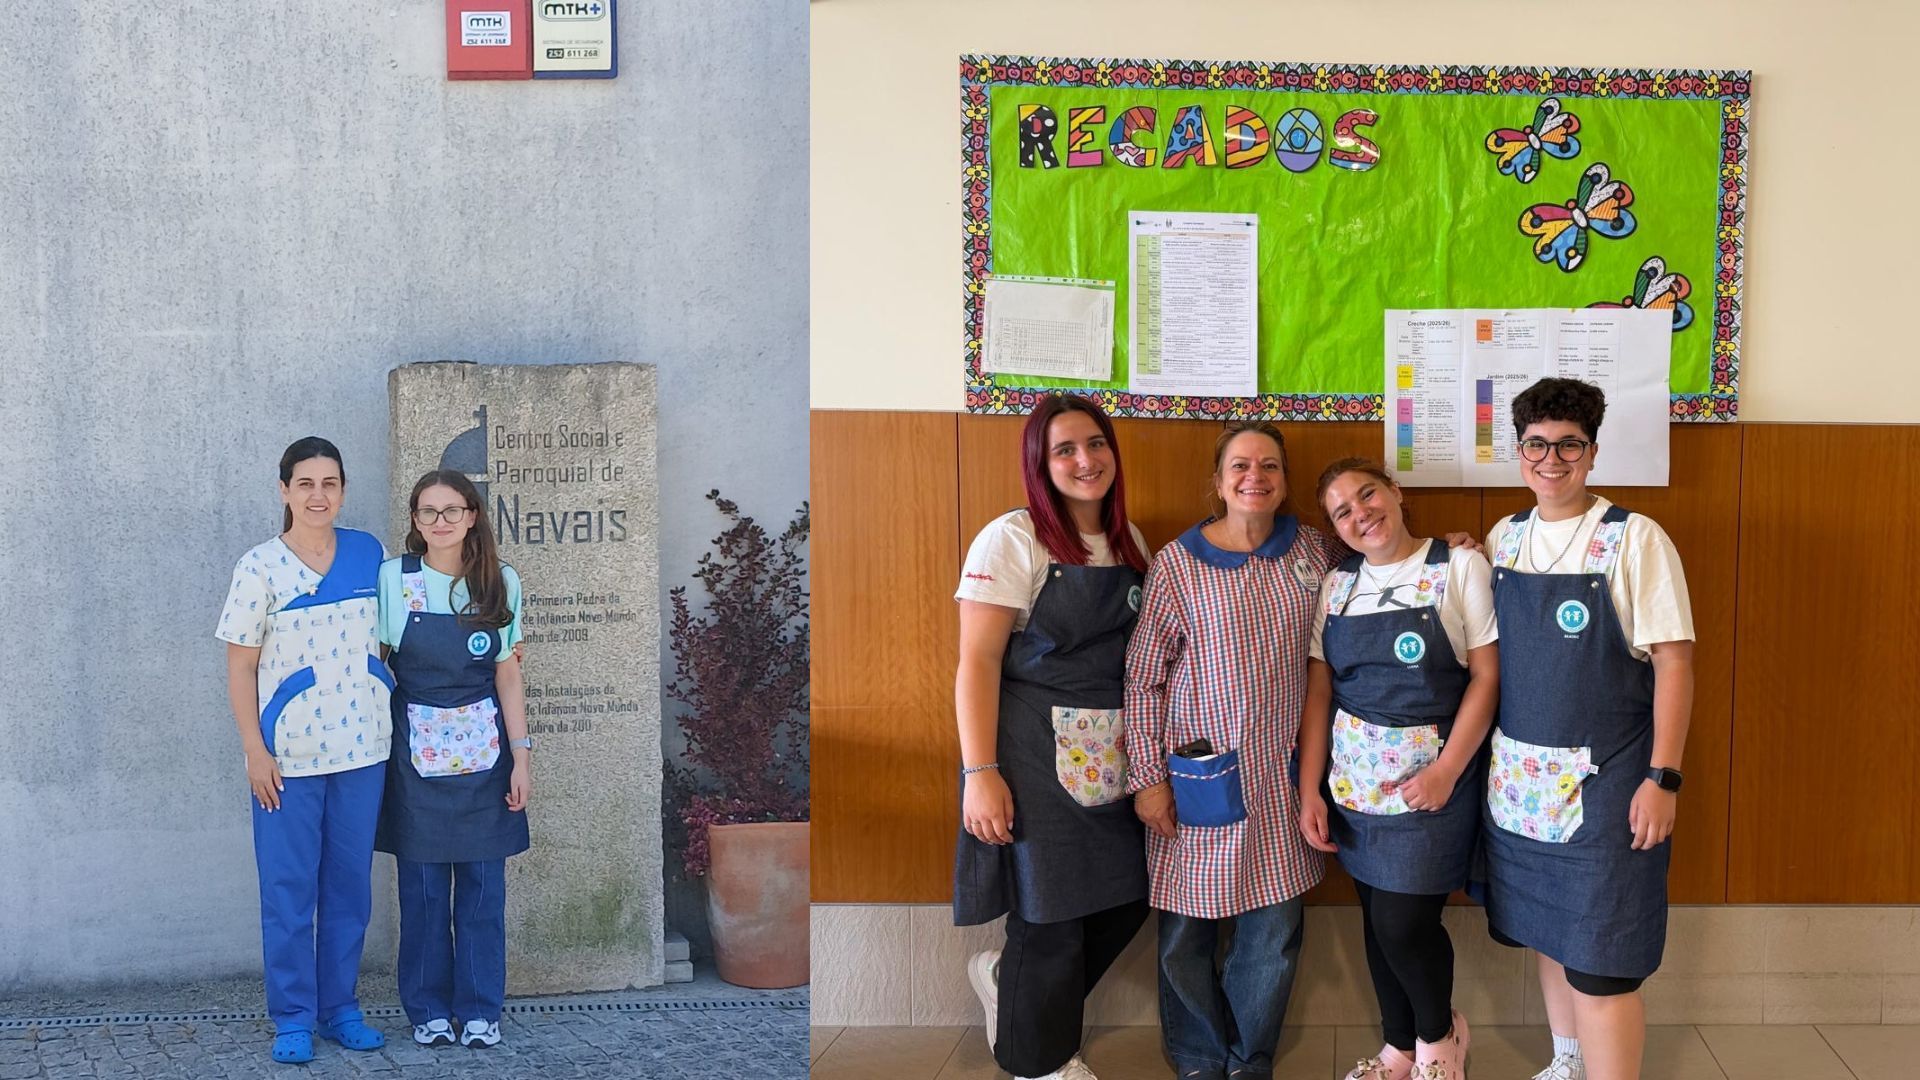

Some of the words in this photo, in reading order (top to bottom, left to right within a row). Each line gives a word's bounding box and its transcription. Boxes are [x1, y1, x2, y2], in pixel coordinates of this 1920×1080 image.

[567, 49, 581, 57] 611
[1018, 104, 1381, 173] RECADOS
[495, 425, 551, 449] Centro
[559, 424, 609, 448] Social
[615, 432, 624, 447] e
[496, 459, 593, 488] Paroquial
[602, 459, 624, 482] de
[496, 494, 627, 545] Navais
[530, 594, 573, 606] Primeira
[576, 592, 605, 605] Pedra
[609, 592, 620, 604] da
[562, 628, 588, 641] 2009
[525, 685, 542, 698] das
